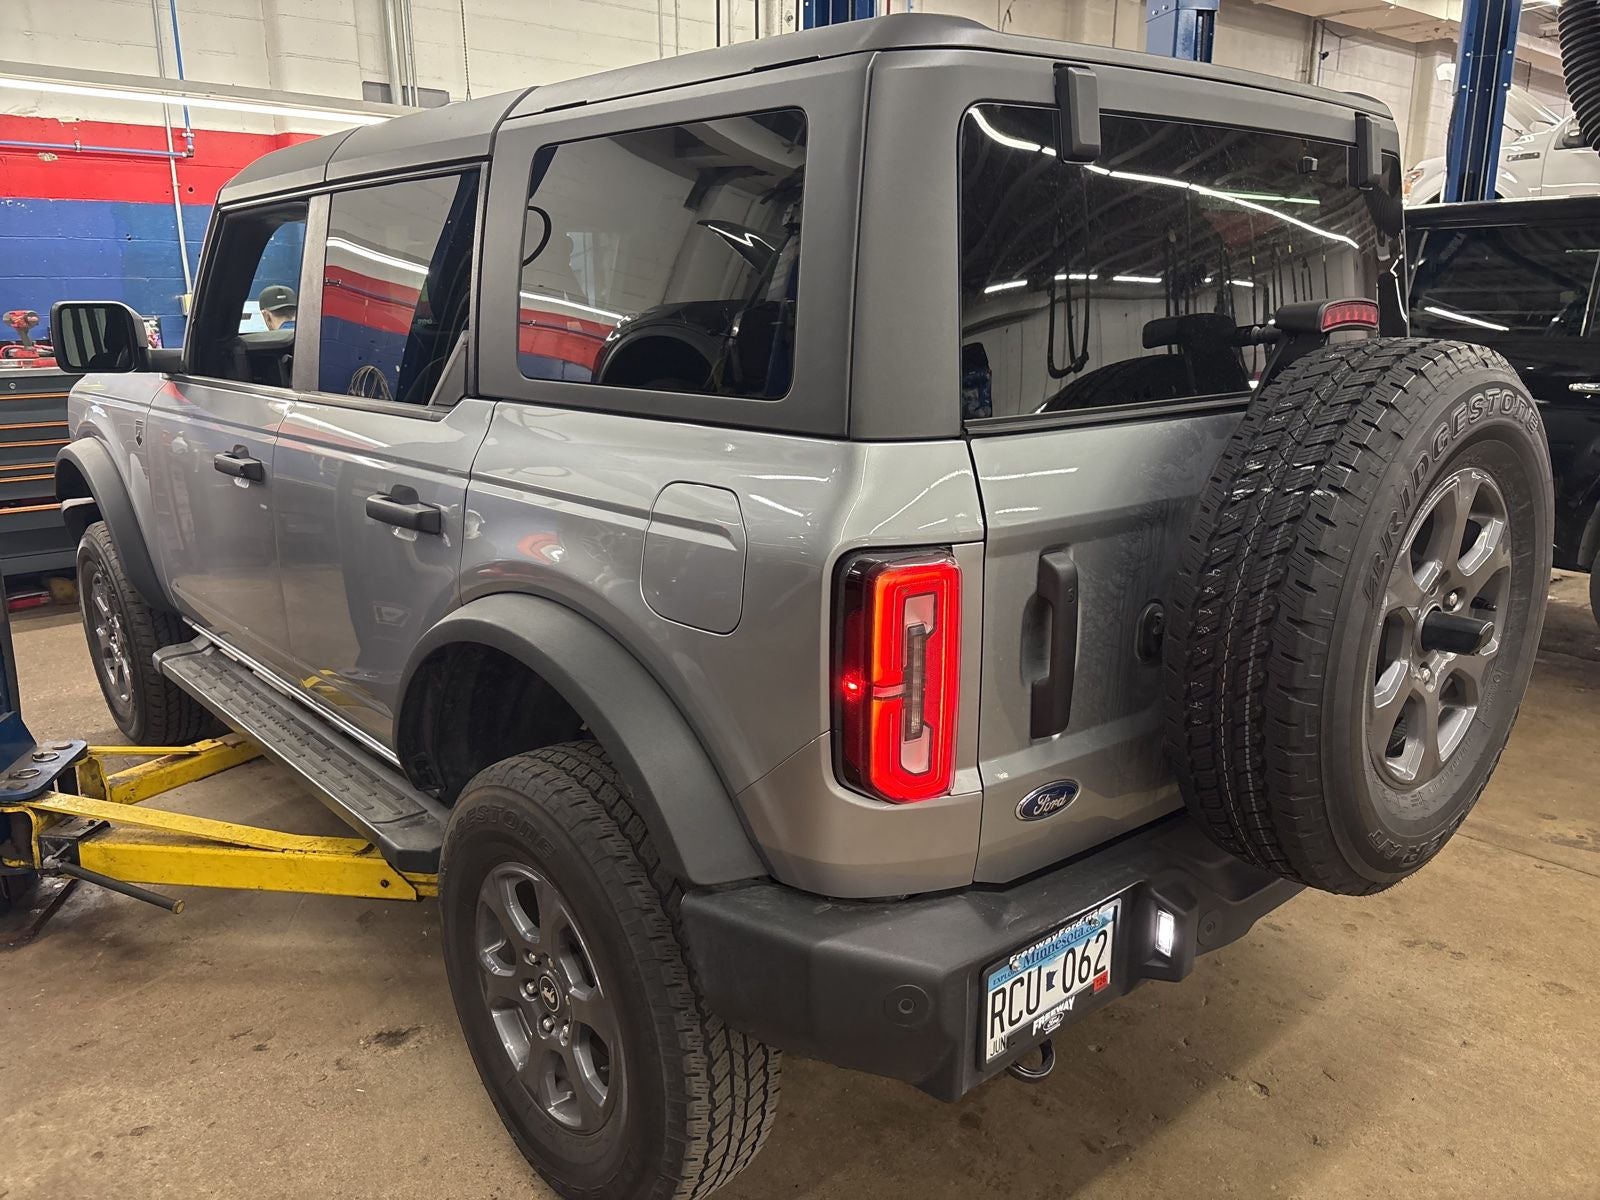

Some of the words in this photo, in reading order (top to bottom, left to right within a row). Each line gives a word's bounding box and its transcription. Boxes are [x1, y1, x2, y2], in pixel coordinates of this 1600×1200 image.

[1033, 790, 1068, 816] Ford
[990, 965, 1042, 1040] RCU
[1062, 929, 1107, 995] 062
[1032, 995, 1075, 1037] FREEWAY
[989, 1035, 1006, 1057] JUN
